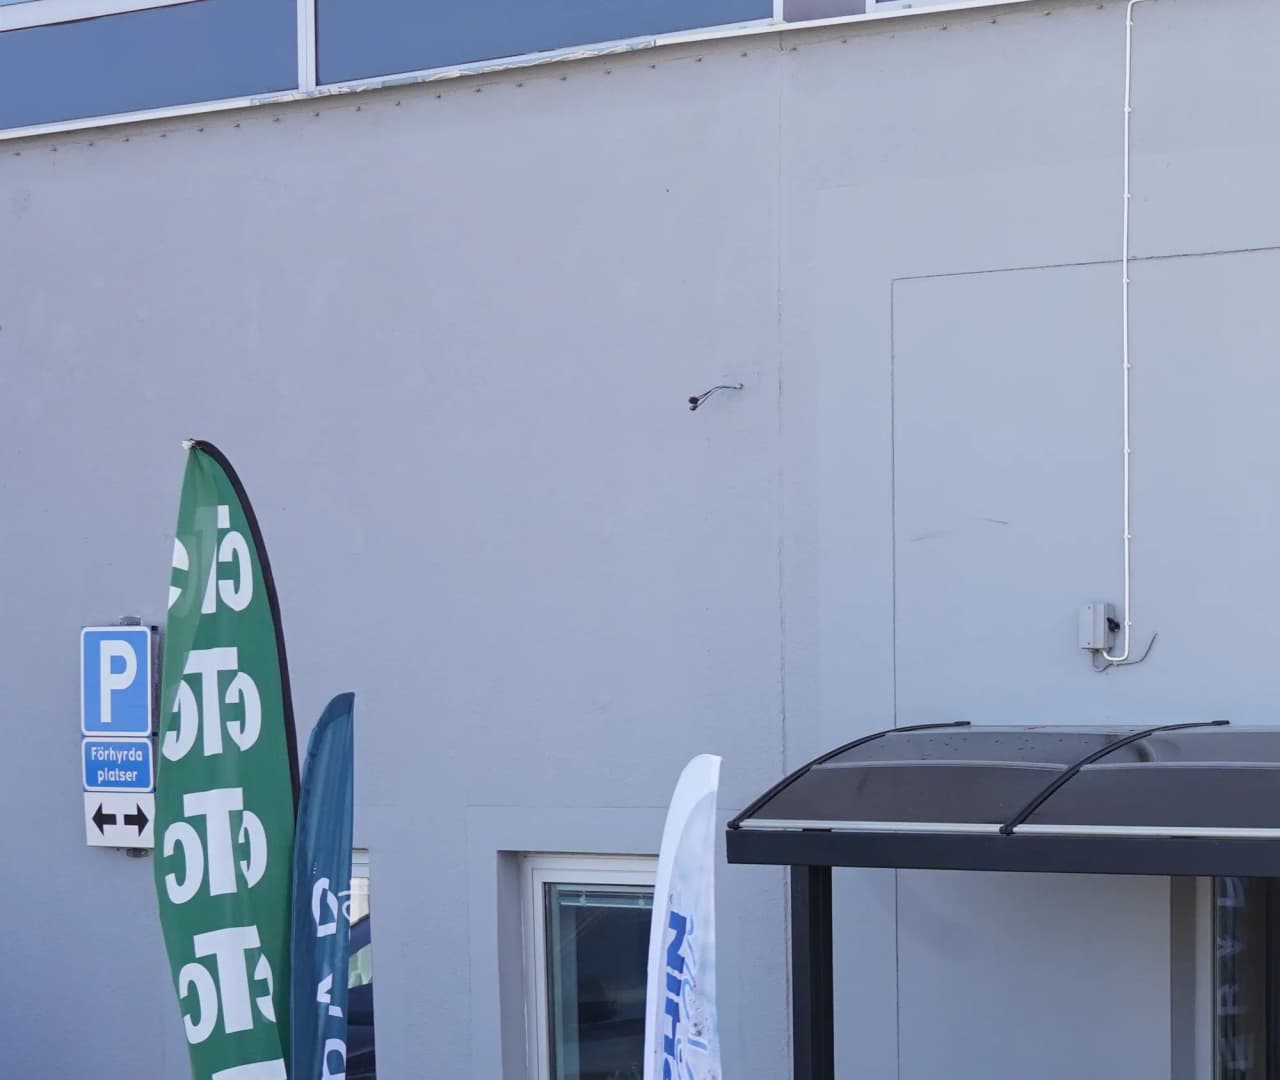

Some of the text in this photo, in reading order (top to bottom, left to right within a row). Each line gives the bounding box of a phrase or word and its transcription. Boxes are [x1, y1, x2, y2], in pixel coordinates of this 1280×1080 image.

[100, 639, 138, 723] P
[91, 746, 143, 764] Förhyrda
[97, 767, 138, 784] platser
